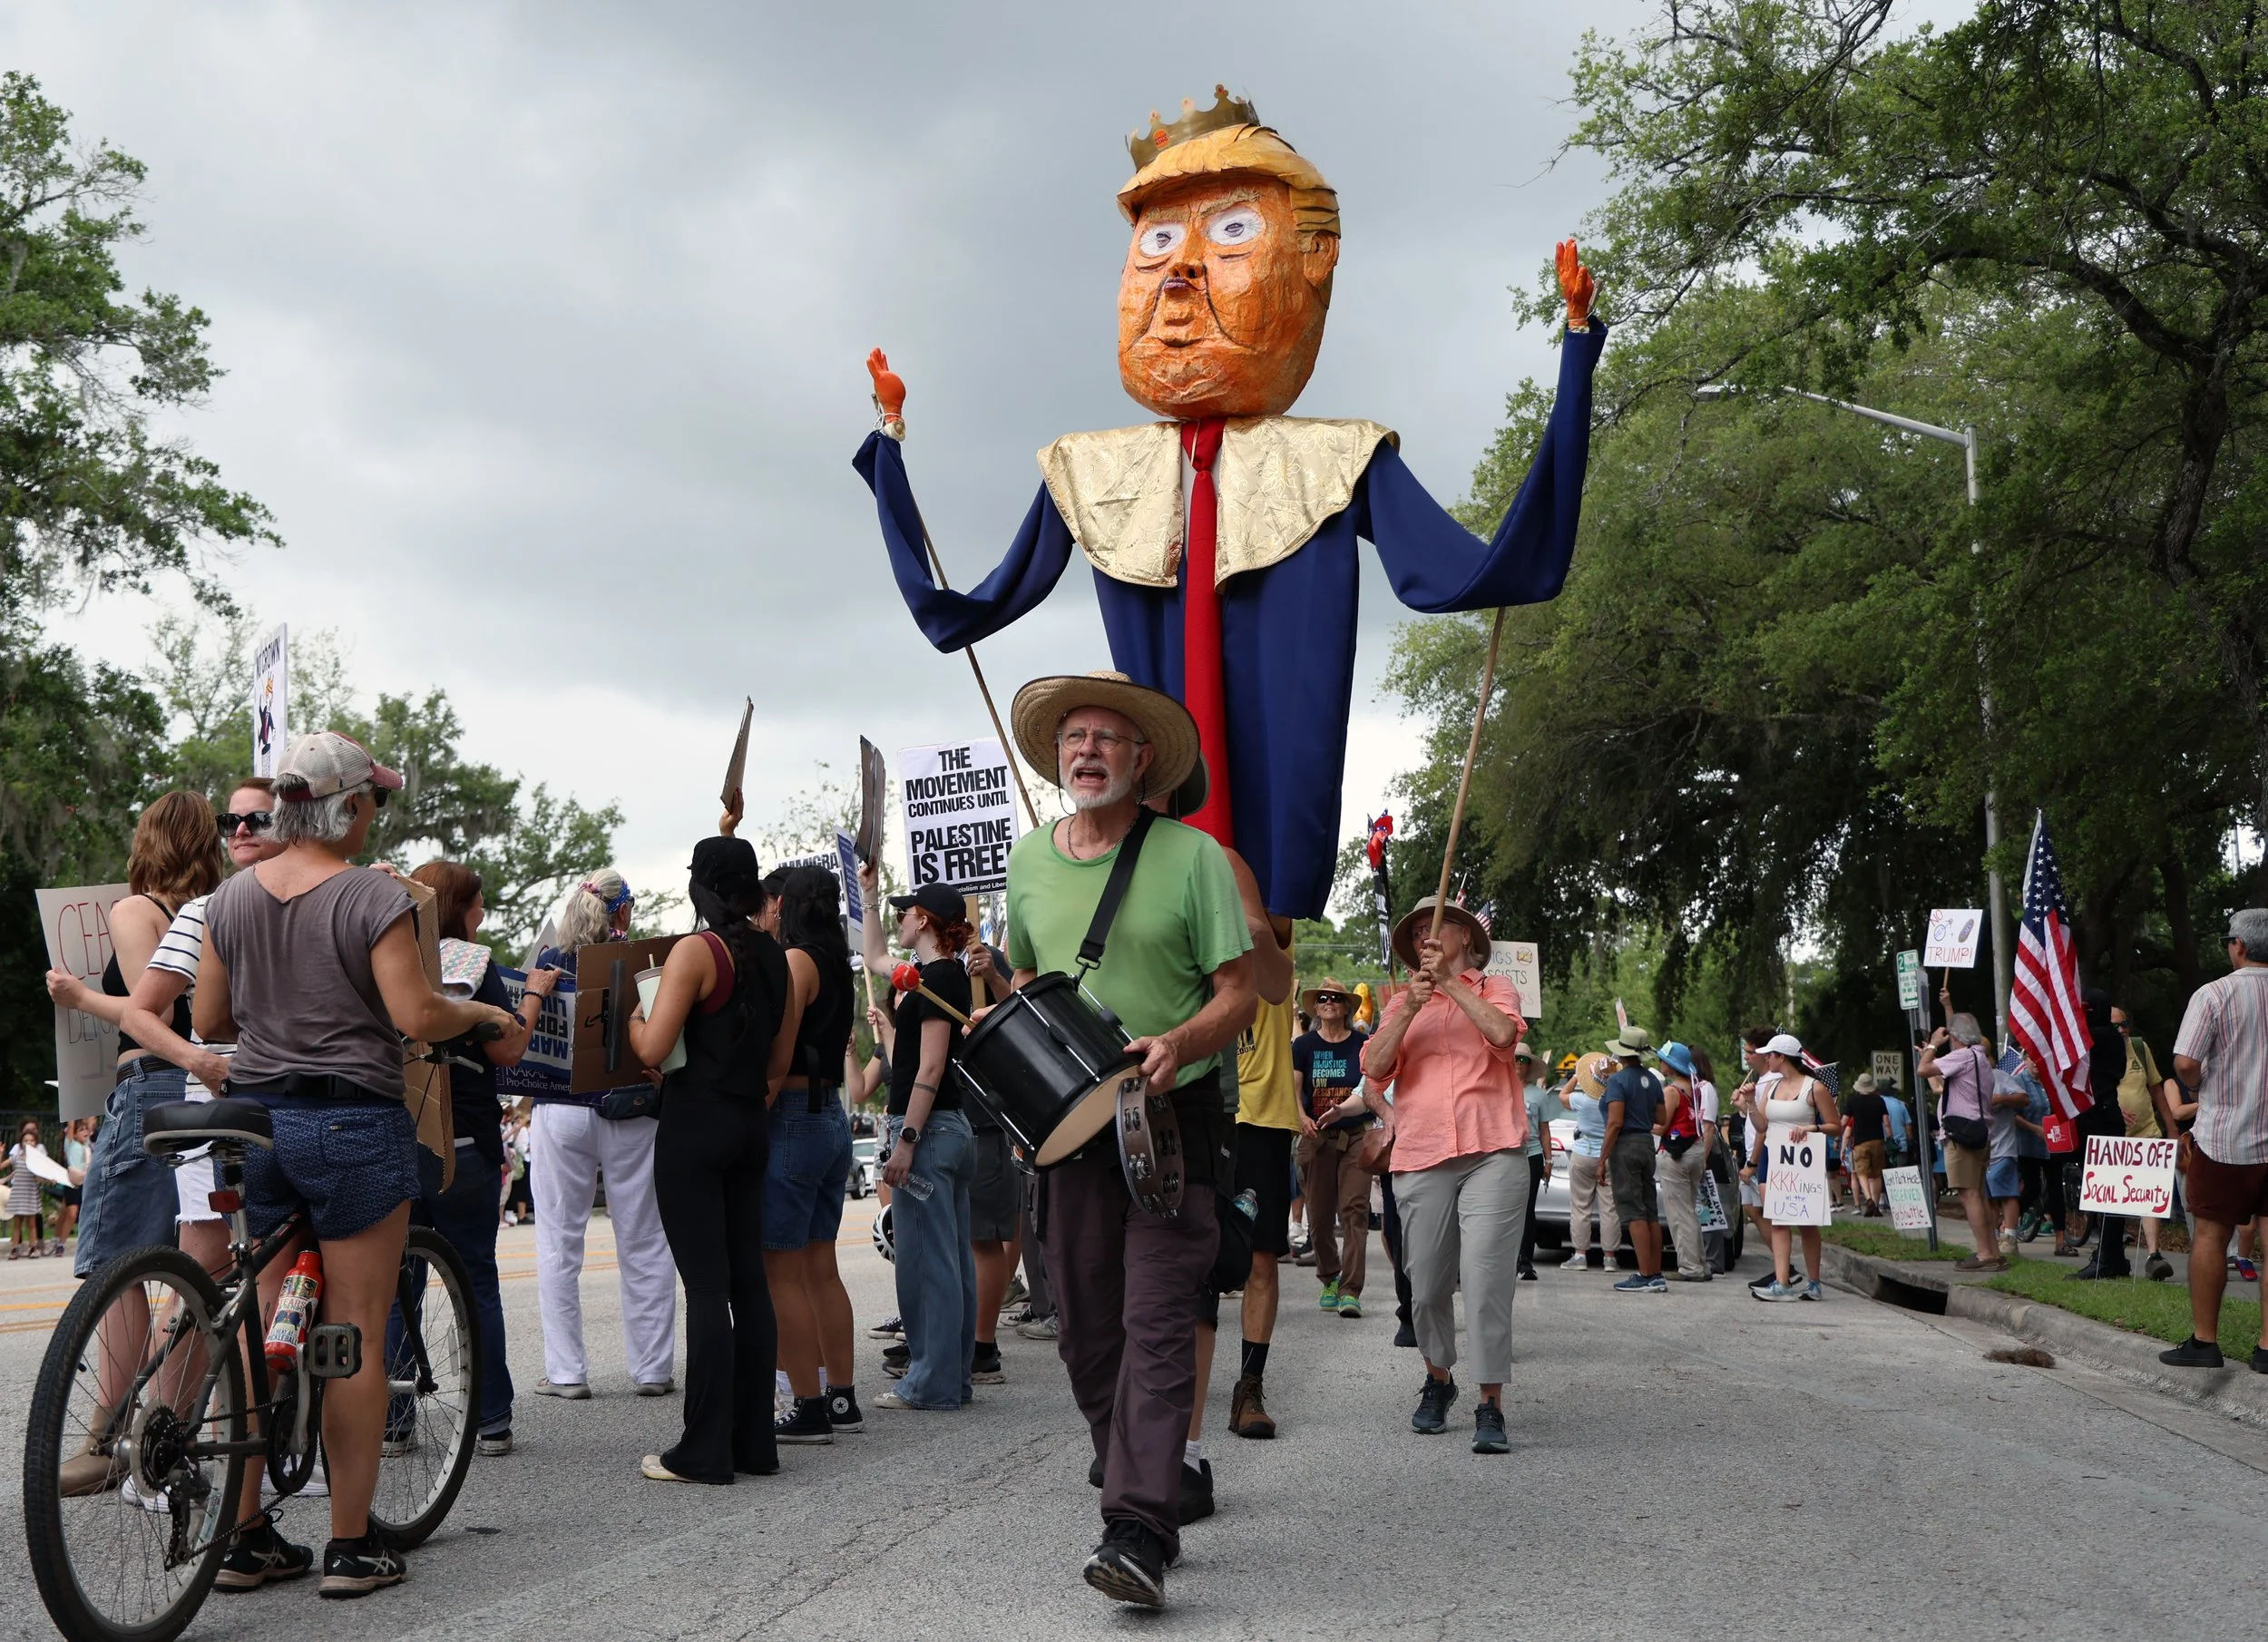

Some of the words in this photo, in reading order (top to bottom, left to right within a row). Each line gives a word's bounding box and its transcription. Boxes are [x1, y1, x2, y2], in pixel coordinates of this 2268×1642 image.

[938, 747, 972, 771] THE
[905, 765, 1007, 801] MOVEMENT
[908, 795, 975, 817] CONTINUES
[977, 790, 1010, 808] UNTIL
[911, 817, 1012, 854] PALESTINE
[913, 852, 940, 885] IS
[1930, 909, 1943, 927] NO
[58, 899, 122, 981] CEA
[1899, 955, 1904, 970] 2
[1927, 946, 1974, 963] TRUMP!
[1314, 1051, 1334, 1060] WHEN
[1875, 1054, 1899, 1064] ONE
[1312, 1068, 1346, 1078] BECOMES
[1313, 1060, 1347, 1069] INJUSTICE
[1875, 1065, 1899, 1075] WAY
[506, 1078, 548, 1090] Pro-Choice
[1312, 1078, 1328, 1088] LAW
[1780, 1145, 1813, 1168] NO
[2087, 1138, 2143, 1167] HANDS
[2147, 1140, 2174, 1168] OFF
[1774, 1201, 1810, 1218] USA
